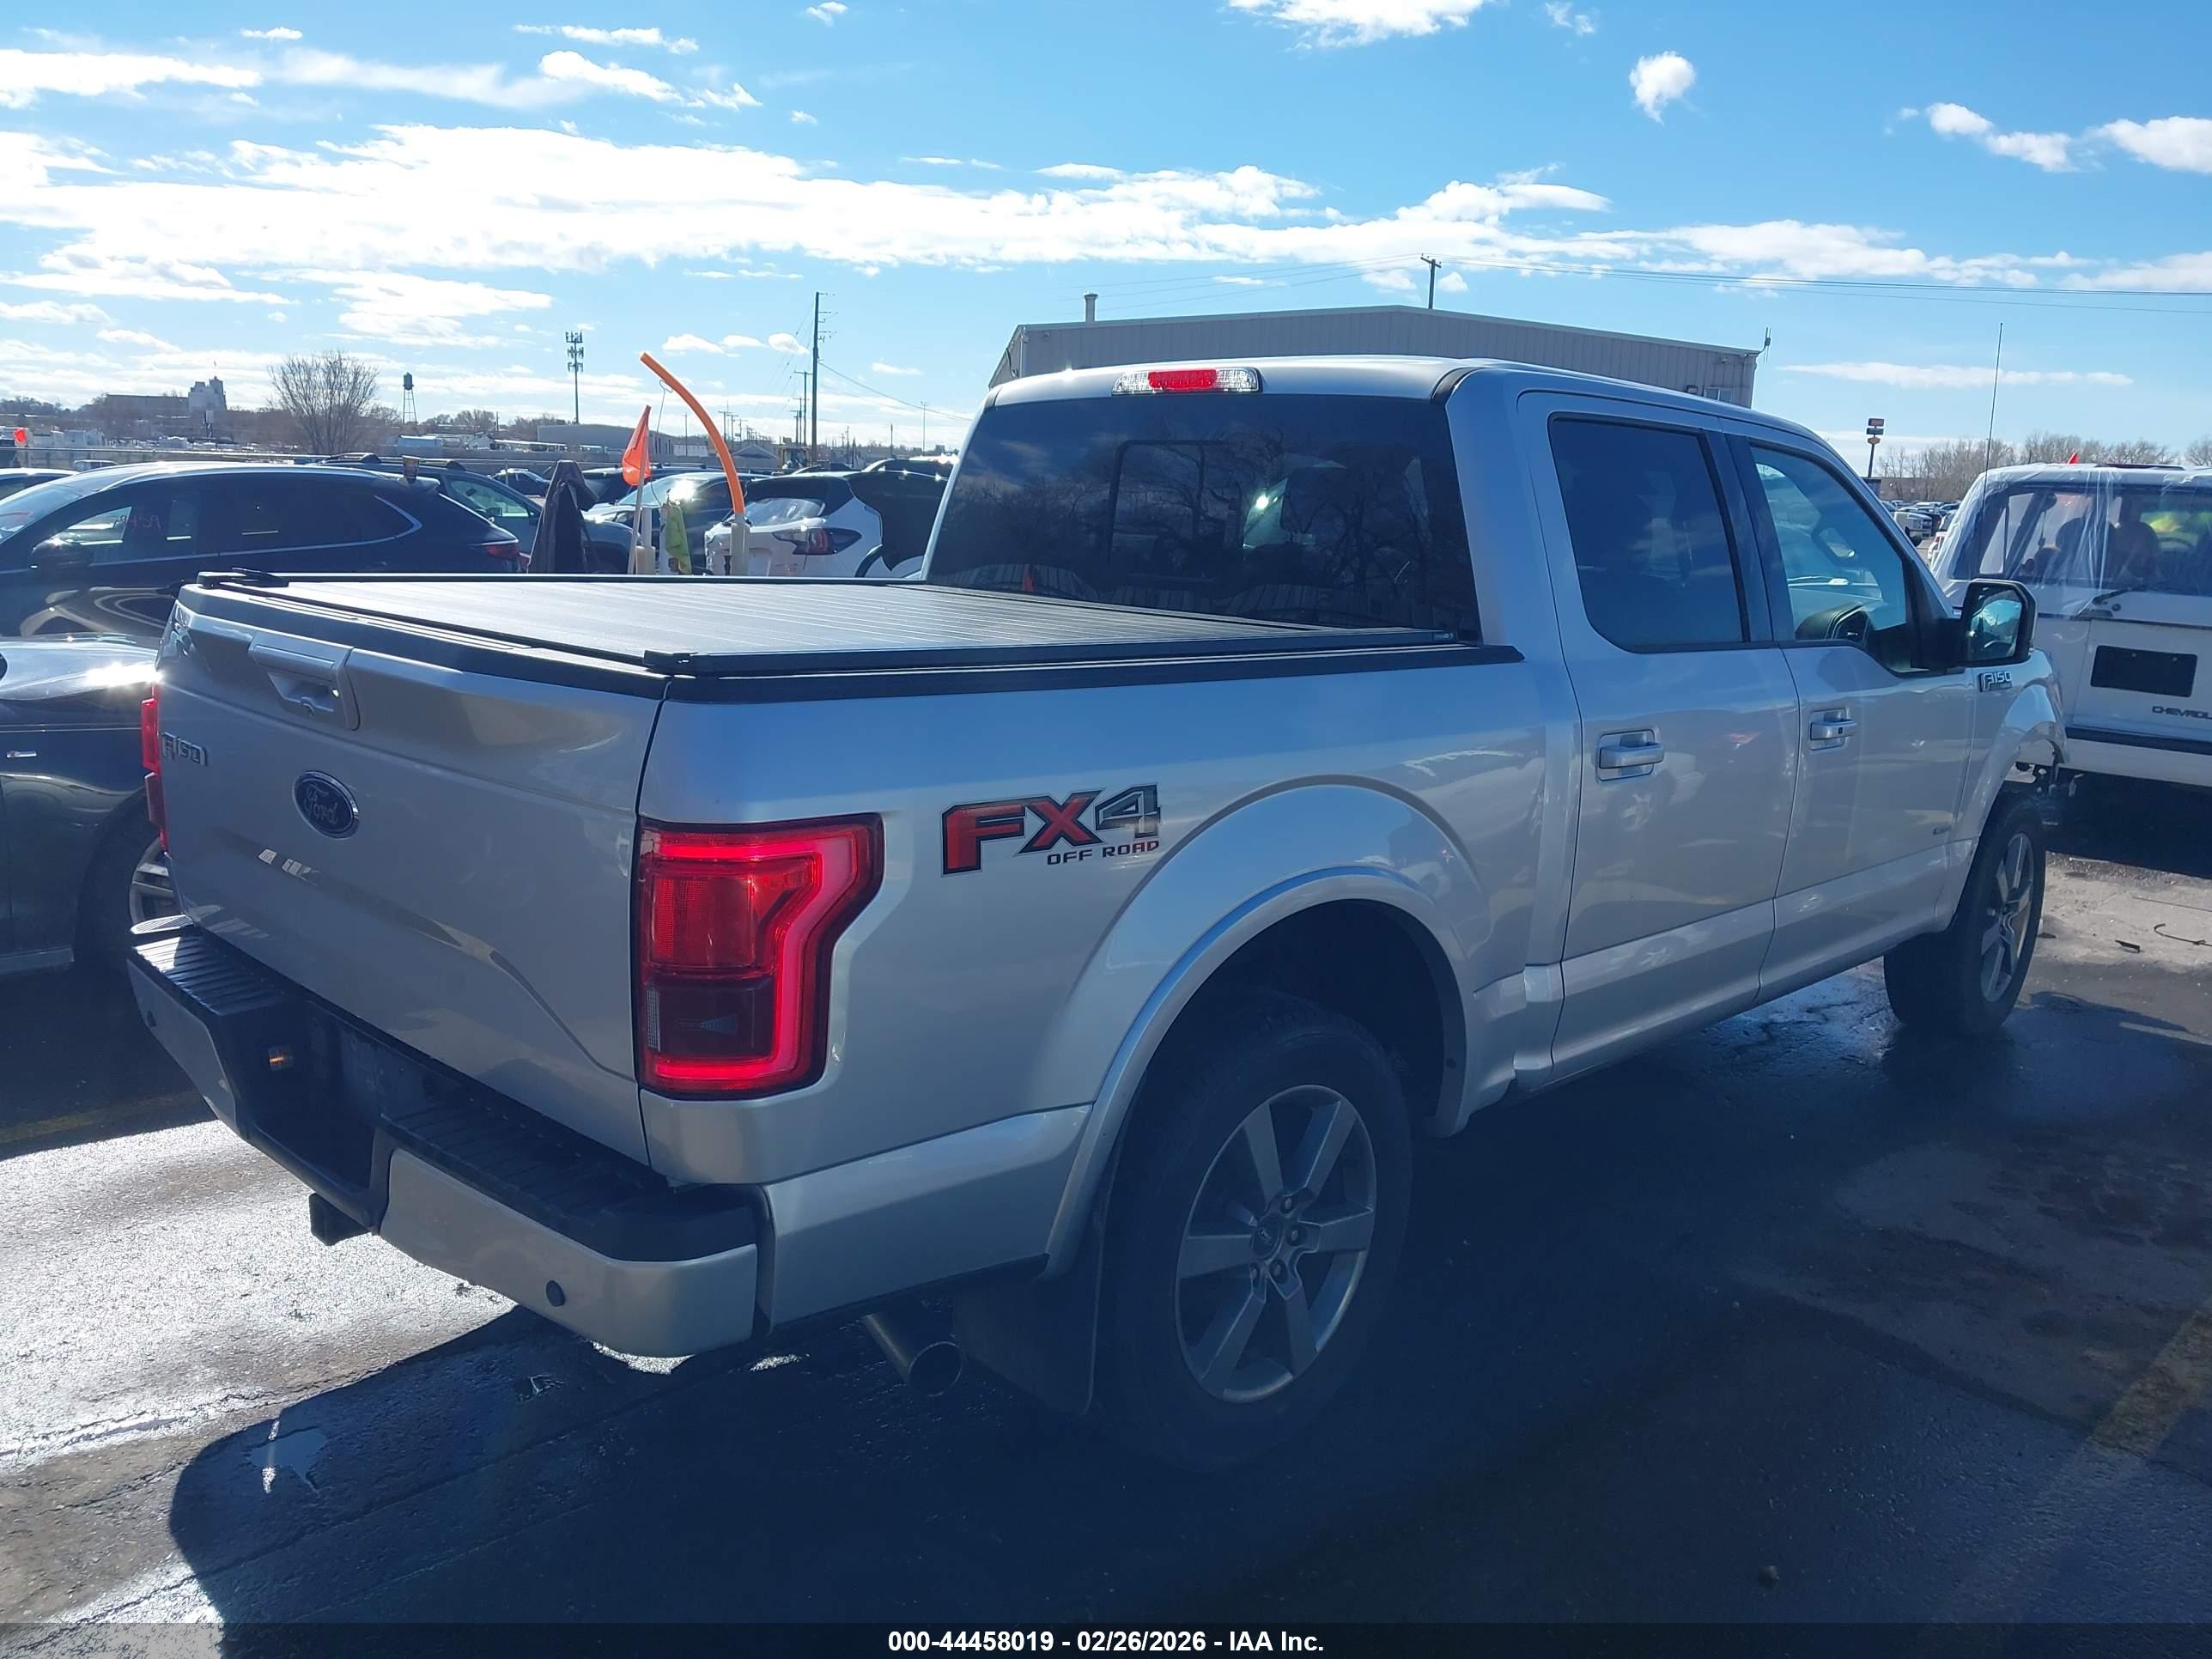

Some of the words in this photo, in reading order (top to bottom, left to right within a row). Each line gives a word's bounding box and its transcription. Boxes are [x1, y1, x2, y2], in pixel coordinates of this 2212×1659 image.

[941, 783, 1160, 876] FX4
[1047, 848, 1093, 866] OFF
[1102, 841, 1159, 859] ROAD
